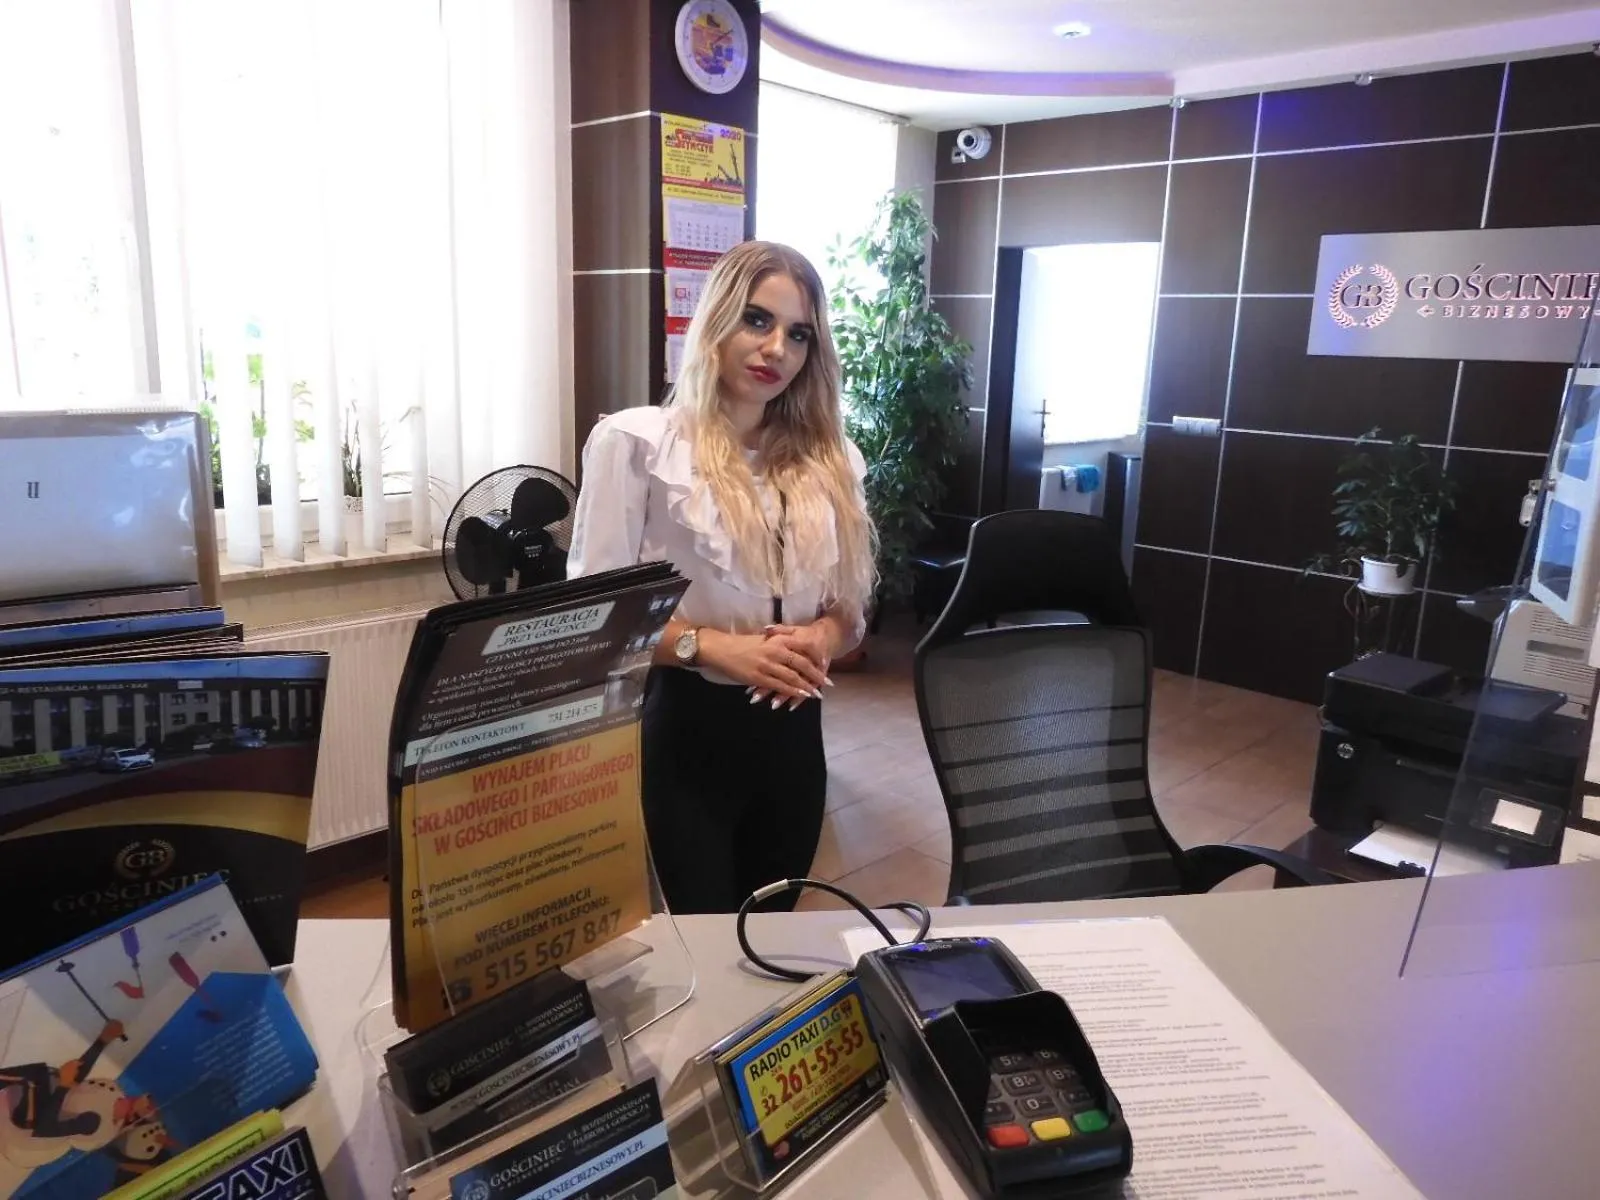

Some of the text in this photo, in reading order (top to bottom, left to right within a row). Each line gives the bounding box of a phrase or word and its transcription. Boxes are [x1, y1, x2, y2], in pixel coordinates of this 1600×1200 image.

[1340, 284, 1384, 309] GB
[1442, 304, 1591, 319] BIZNESOWY
[504, 607, 599, 637] RESTAURACJA
[473, 756, 546, 794] WYNAJEM
[549, 742, 591, 772] PLACU
[412, 787, 519, 839] SKŁADOWEGO
[532, 752, 634, 801] PARKINGOWEGO
[434, 831, 451, 857] W
[532, 779, 619, 824] BIZNESOWYM
[475, 887, 592, 944] WIĘCEJ INFORMACJI
[454, 949, 484, 970] POD
[486, 921, 549, 956] NUMEREM
[484, 908, 622, 991] 515 567 847
[749, 1042, 792, 1082] RADIO
[791, 1022, 820, 1051] TAXI
[761, 1093, 780, 1117] 32
[775, 1020, 864, 1104] 261-55-55
[1000, 1055, 1011, 1066] 5
[1012, 1076, 1025, 1087] 8
[1027, 1098, 1040, 1109] 0
[490, 1139, 567, 1188] GOŚCINIEC
